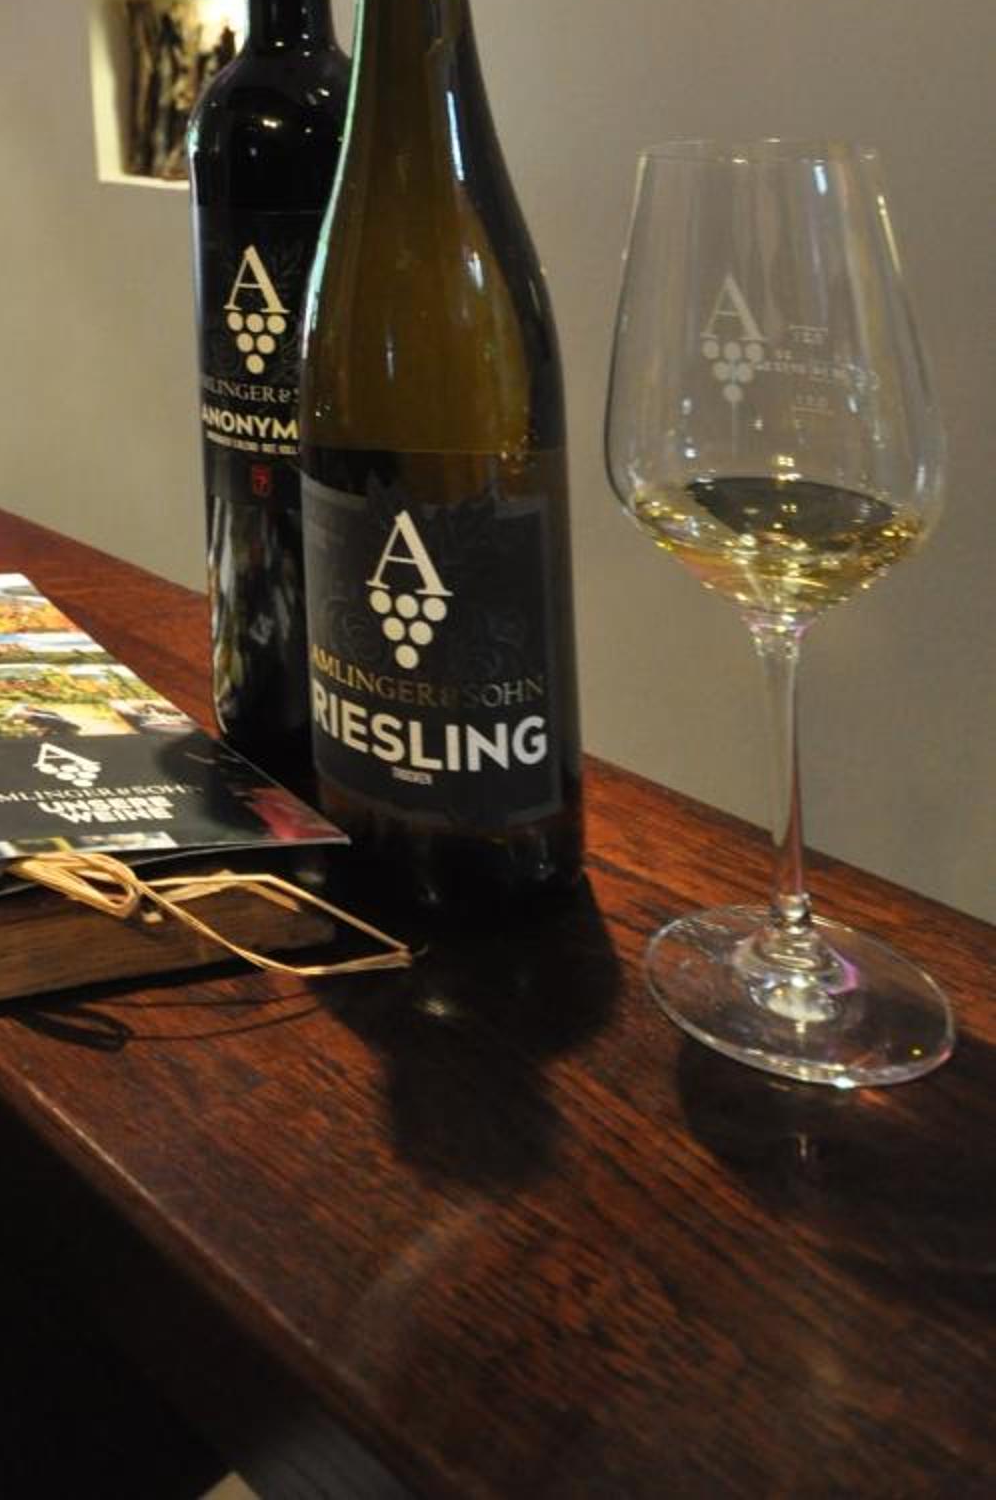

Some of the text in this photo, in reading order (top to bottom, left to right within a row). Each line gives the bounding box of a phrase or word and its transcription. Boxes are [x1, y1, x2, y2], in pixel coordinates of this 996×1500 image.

[223, 244, 290, 314] A
[365, 509, 454, 597] A
[312, 677, 548, 772] RIESLING
[37, 795, 174, 813] UNSERE
[59, 808, 174, 823] WEINE
